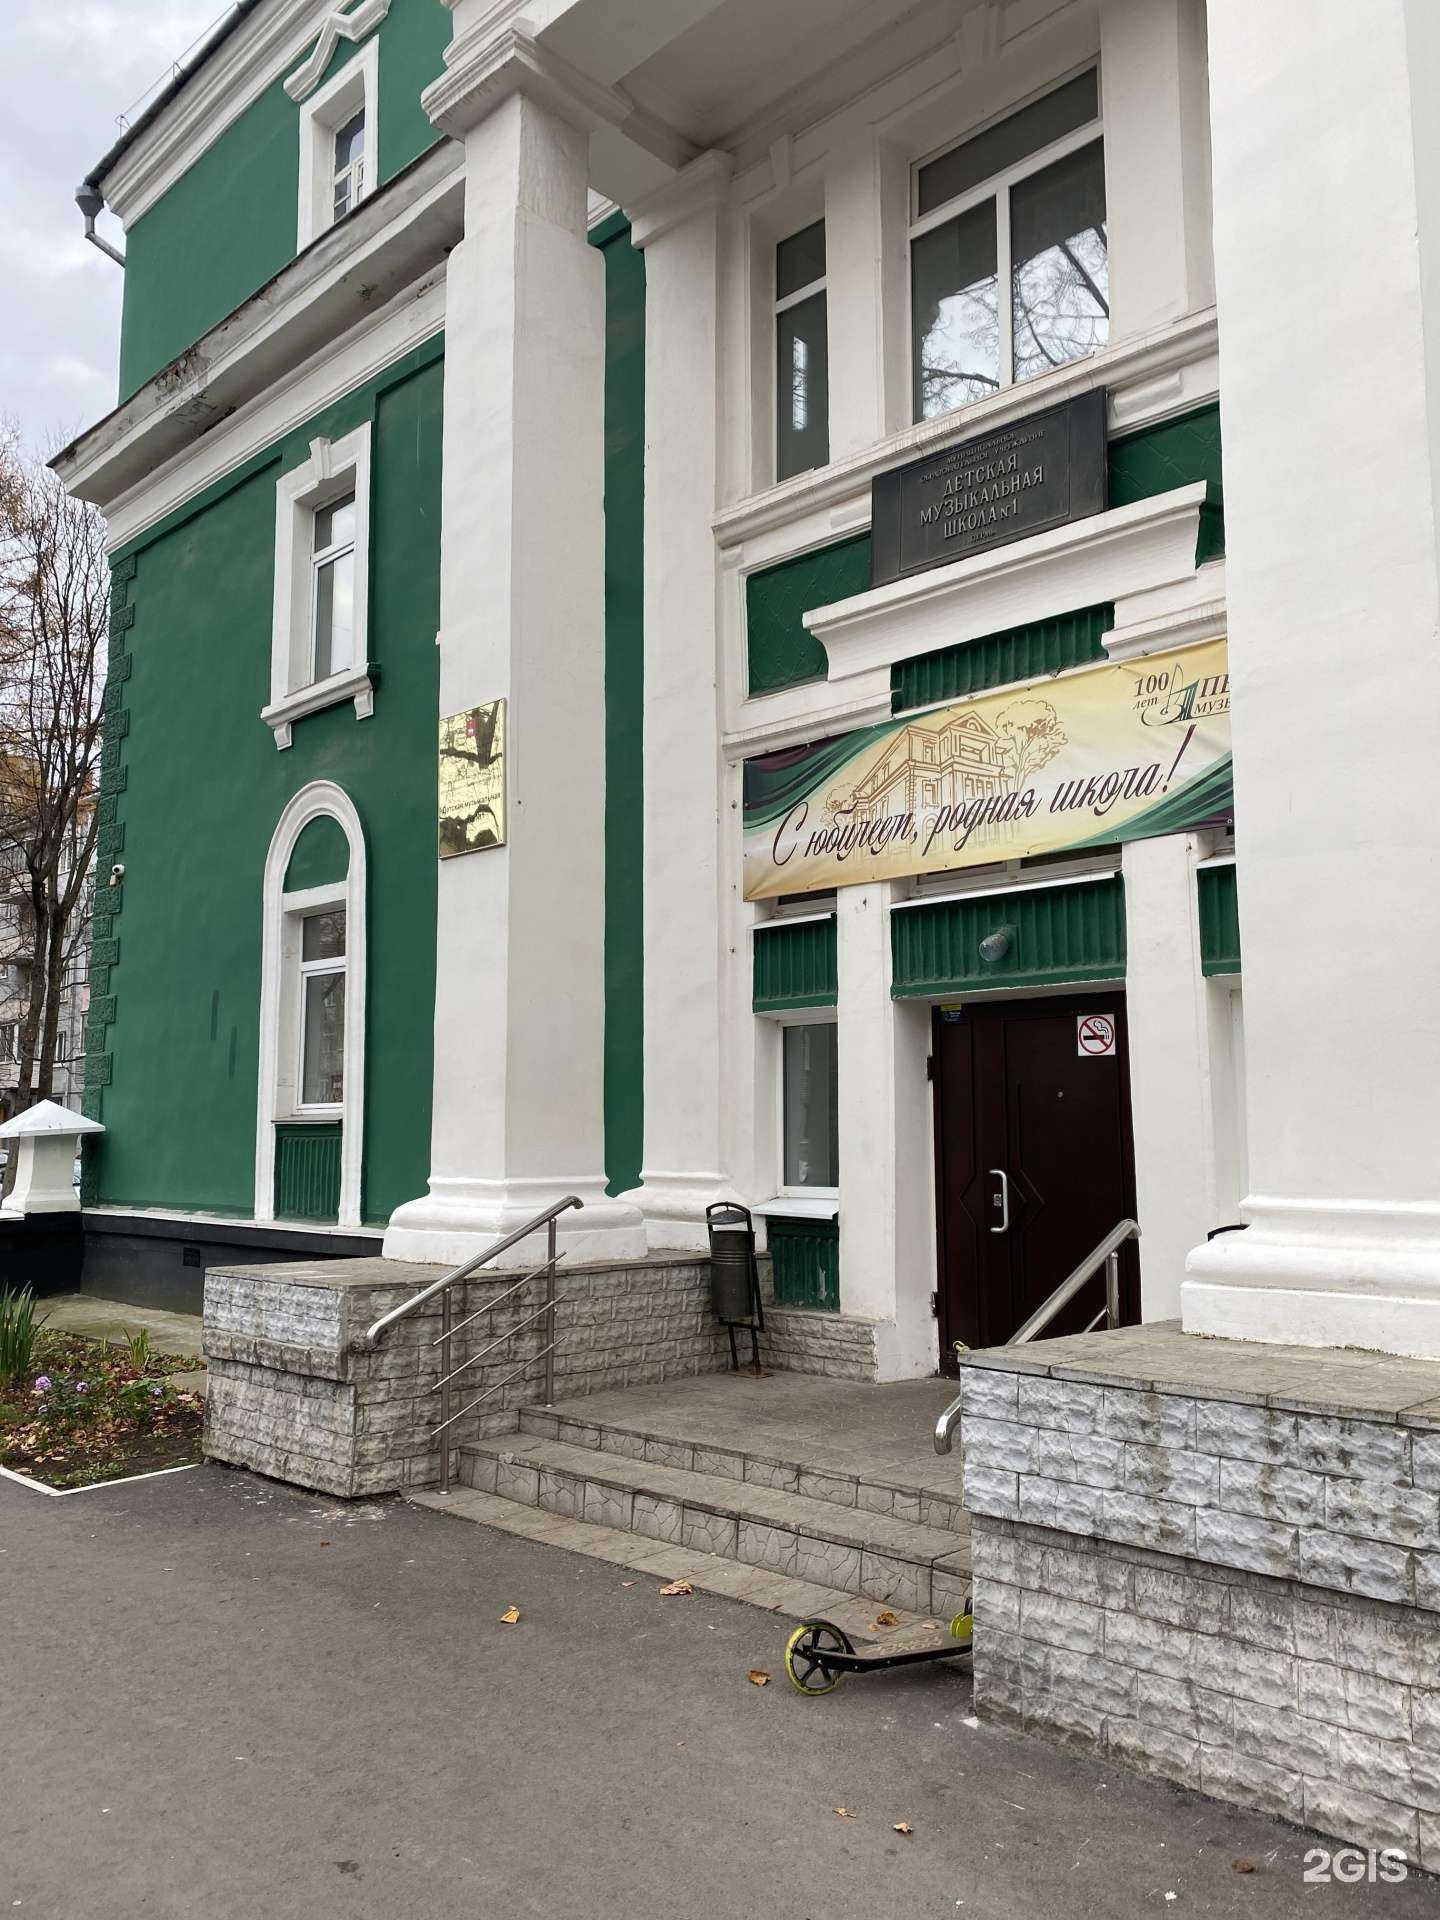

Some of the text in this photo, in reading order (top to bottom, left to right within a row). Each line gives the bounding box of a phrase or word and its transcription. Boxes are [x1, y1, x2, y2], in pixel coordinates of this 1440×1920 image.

[943, 453, 1018, 497] ДЕТСКАЯ
[920, 465, 1044, 525] МУЗЫКАЛЬНАЯ
[944, 506, 997, 539] ШКОЛА
[1132, 696, 1158, 710] лет
[1135, 672, 1169, 697] 100
[773, 802, 808, 865] С
[922, 788, 1042, 856] родная
[1050, 724, 1195, 816] школа!
